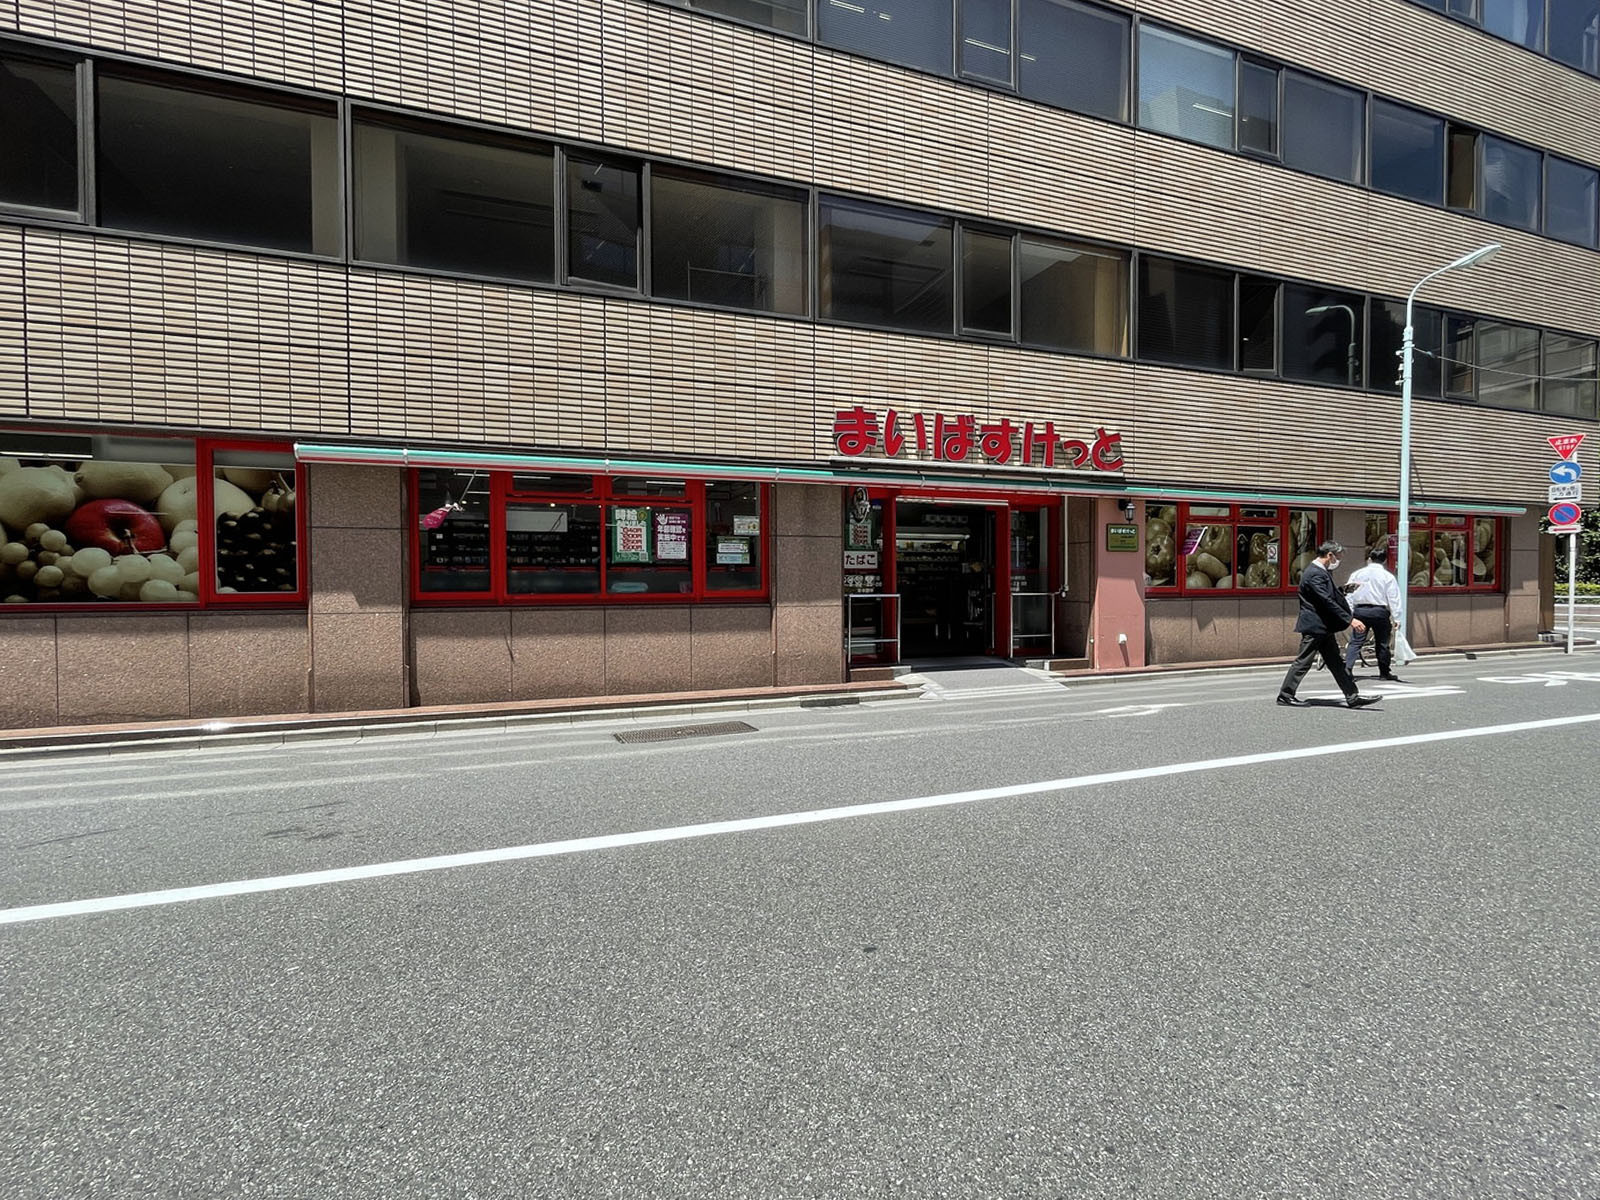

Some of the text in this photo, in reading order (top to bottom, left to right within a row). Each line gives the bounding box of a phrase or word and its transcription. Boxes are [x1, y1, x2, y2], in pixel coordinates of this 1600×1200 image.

[833, 406, 1125, 471] まいばすけっと
[845, 553, 876, 565] たばこ
